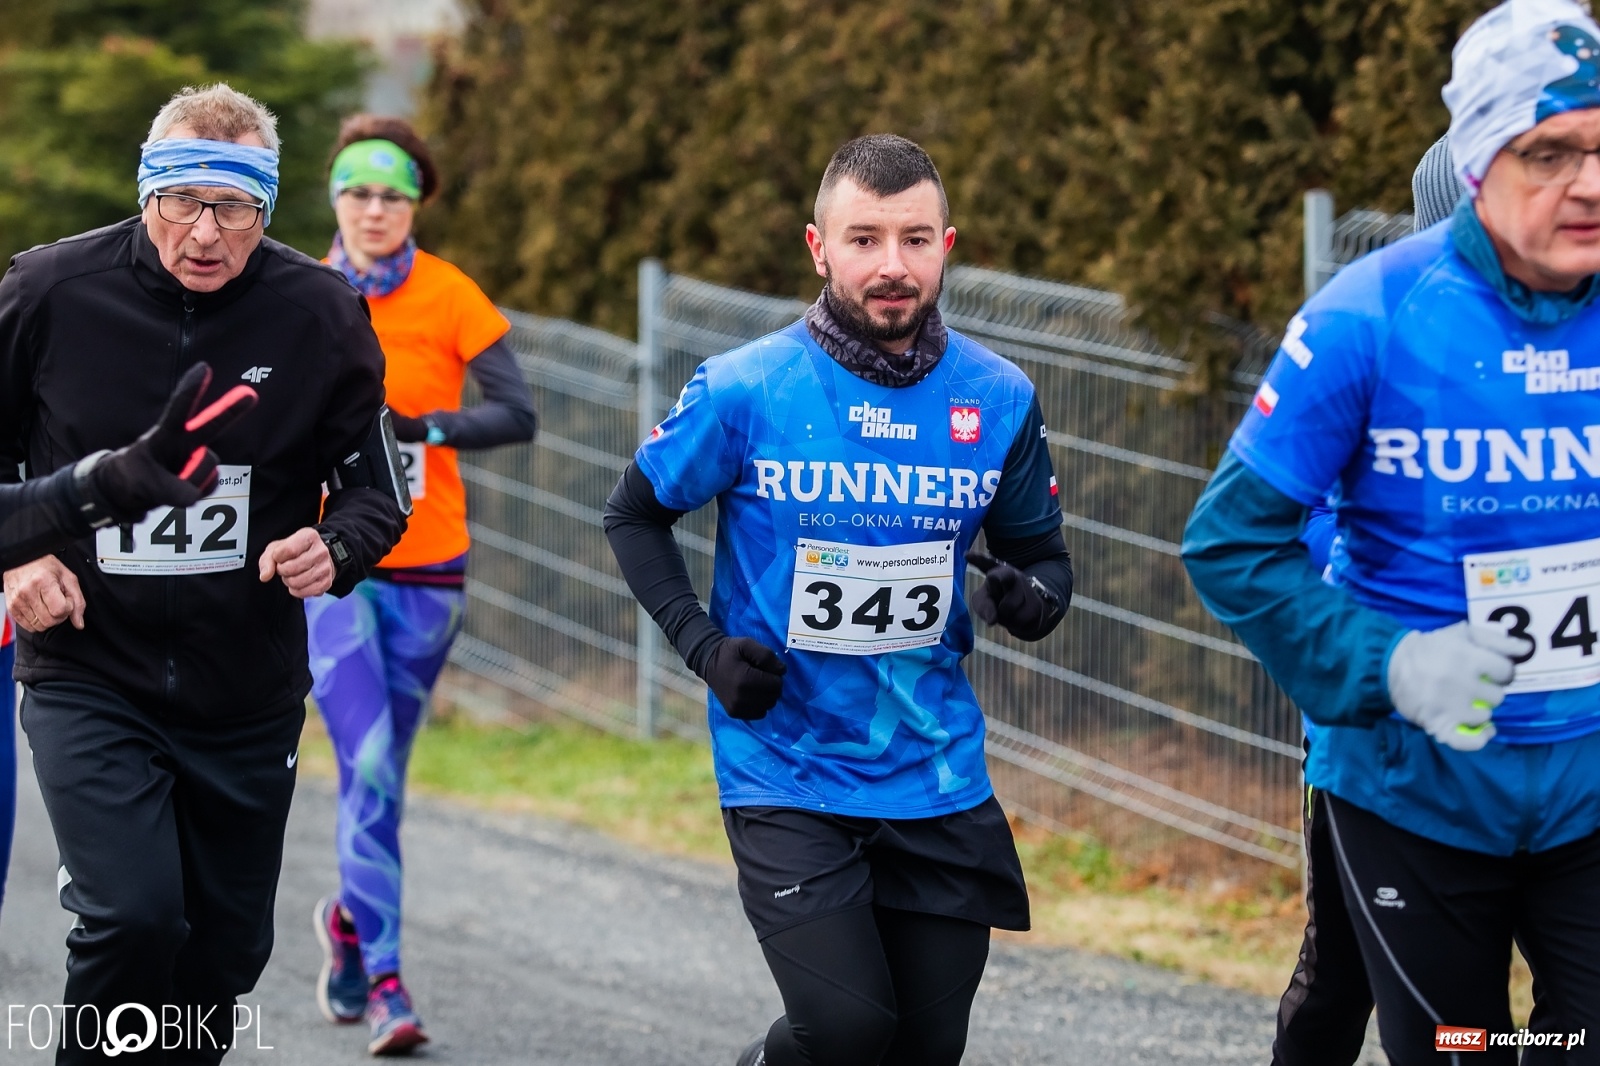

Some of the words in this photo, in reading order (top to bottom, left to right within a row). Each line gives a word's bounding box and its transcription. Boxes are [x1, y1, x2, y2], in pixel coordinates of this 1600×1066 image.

[241, 366, 273, 383] 4F
[949, 397, 980, 405] POLAND
[1368, 427, 1600, 483] RUNN
[754, 460, 1002, 509] RUNNERS
[912, 516, 962, 532] TEAM
[806, 543, 850, 554] PersonalBest
[856, 554, 948, 570] www.personalbest.pl
[801, 581, 941, 634] 343
